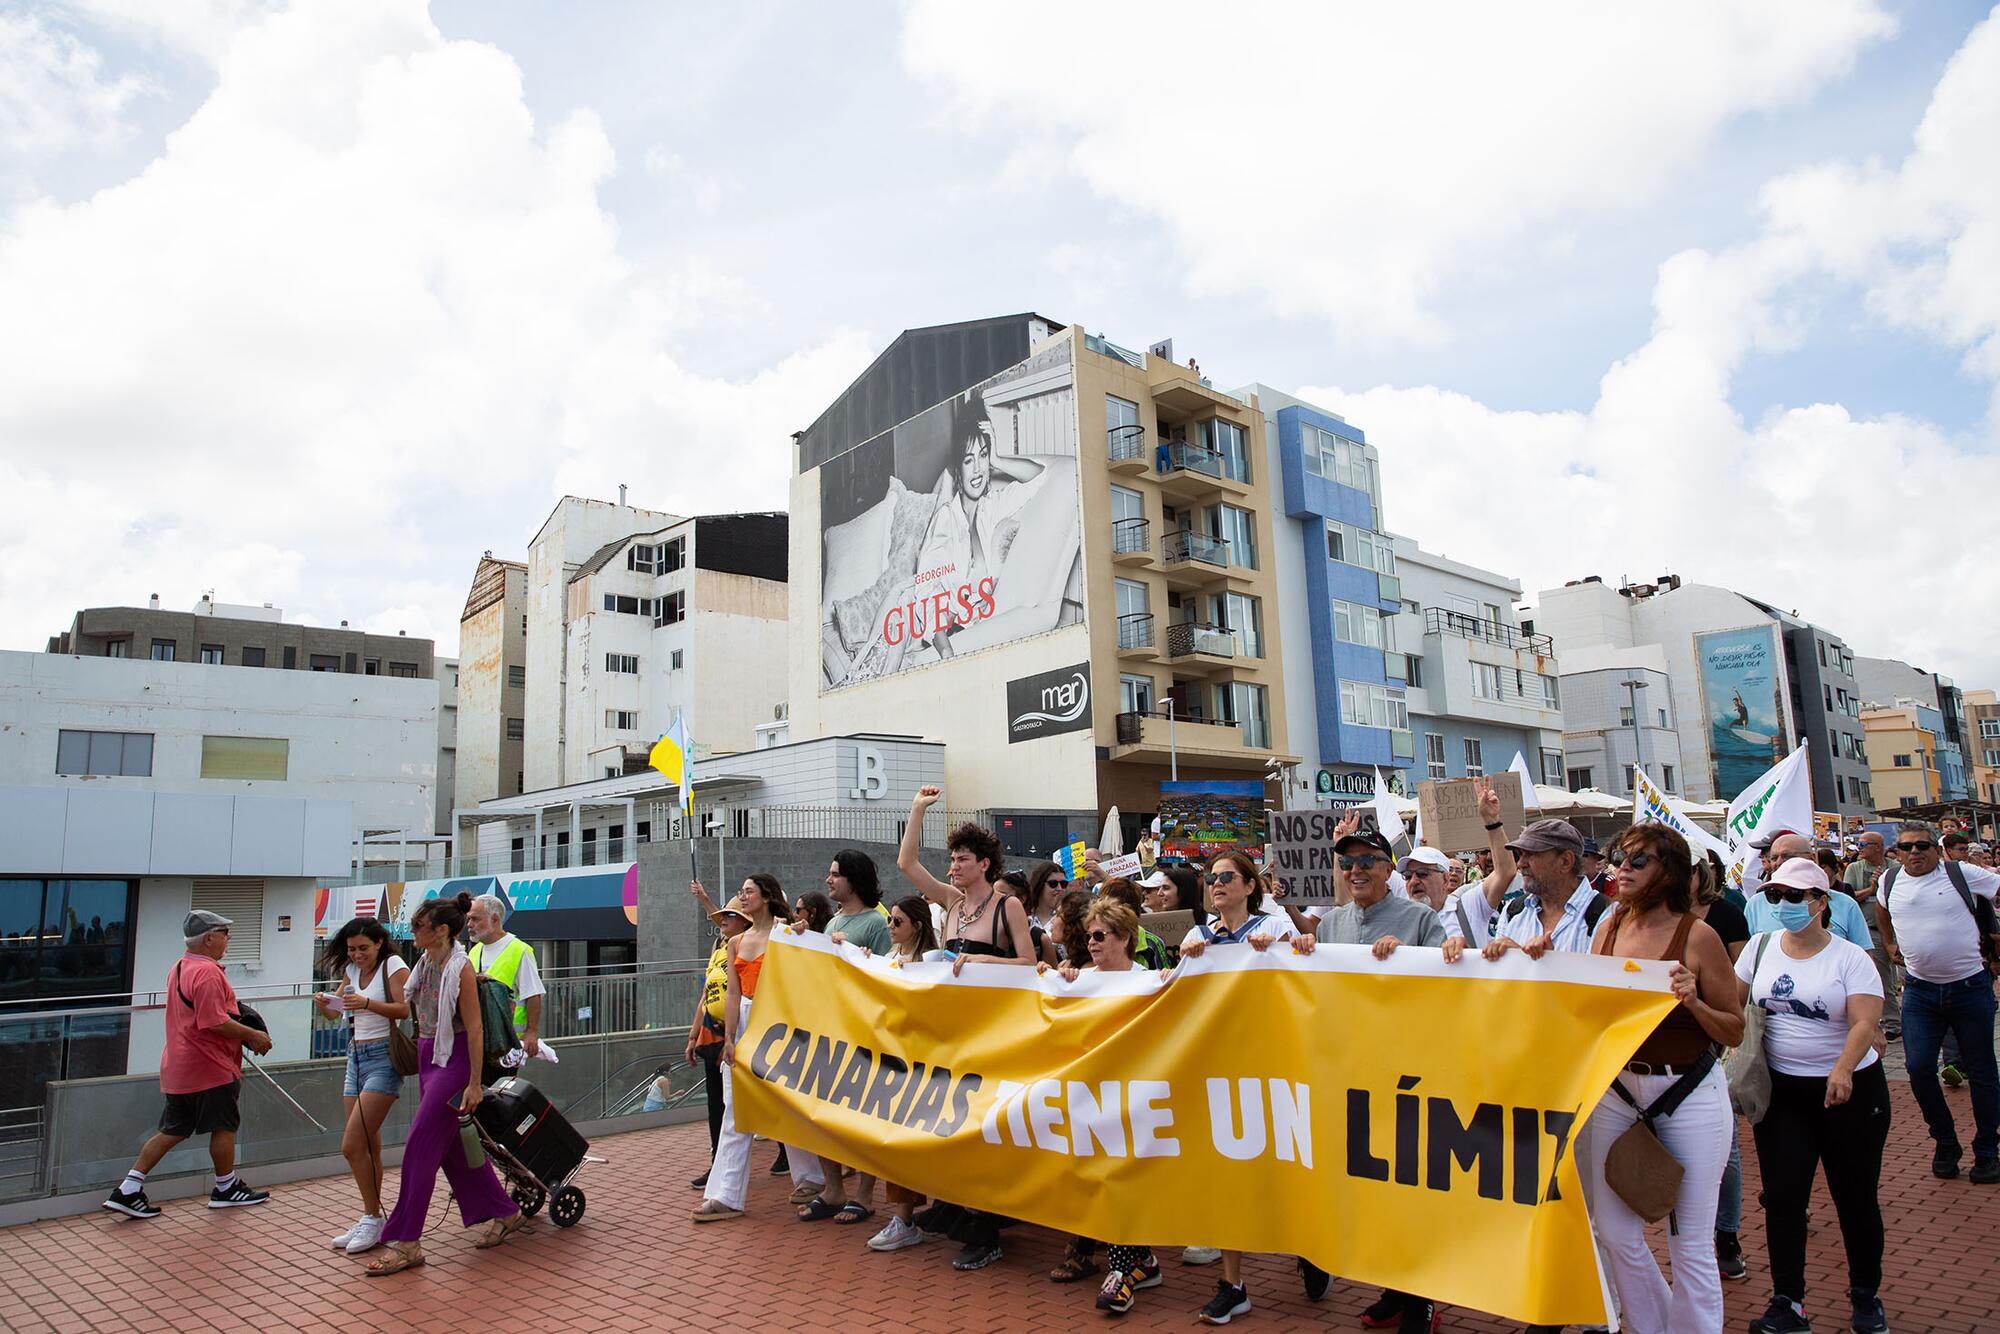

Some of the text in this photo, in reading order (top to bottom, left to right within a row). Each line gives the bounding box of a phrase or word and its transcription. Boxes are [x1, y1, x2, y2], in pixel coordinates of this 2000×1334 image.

[915, 562, 956, 585] GEORGINA
[883, 576, 996, 646] GUESS
[1041, 681, 1079, 711] mar
[1333, 774, 1346, 792] EL
[1274, 816, 1308, 842] NO
[1278, 849, 1303, 870] UN
[1278, 876, 1298, 898] DE
[750, 1023, 983, 1137] CANARIAS
[1206, 1077, 1313, 1169] UN
